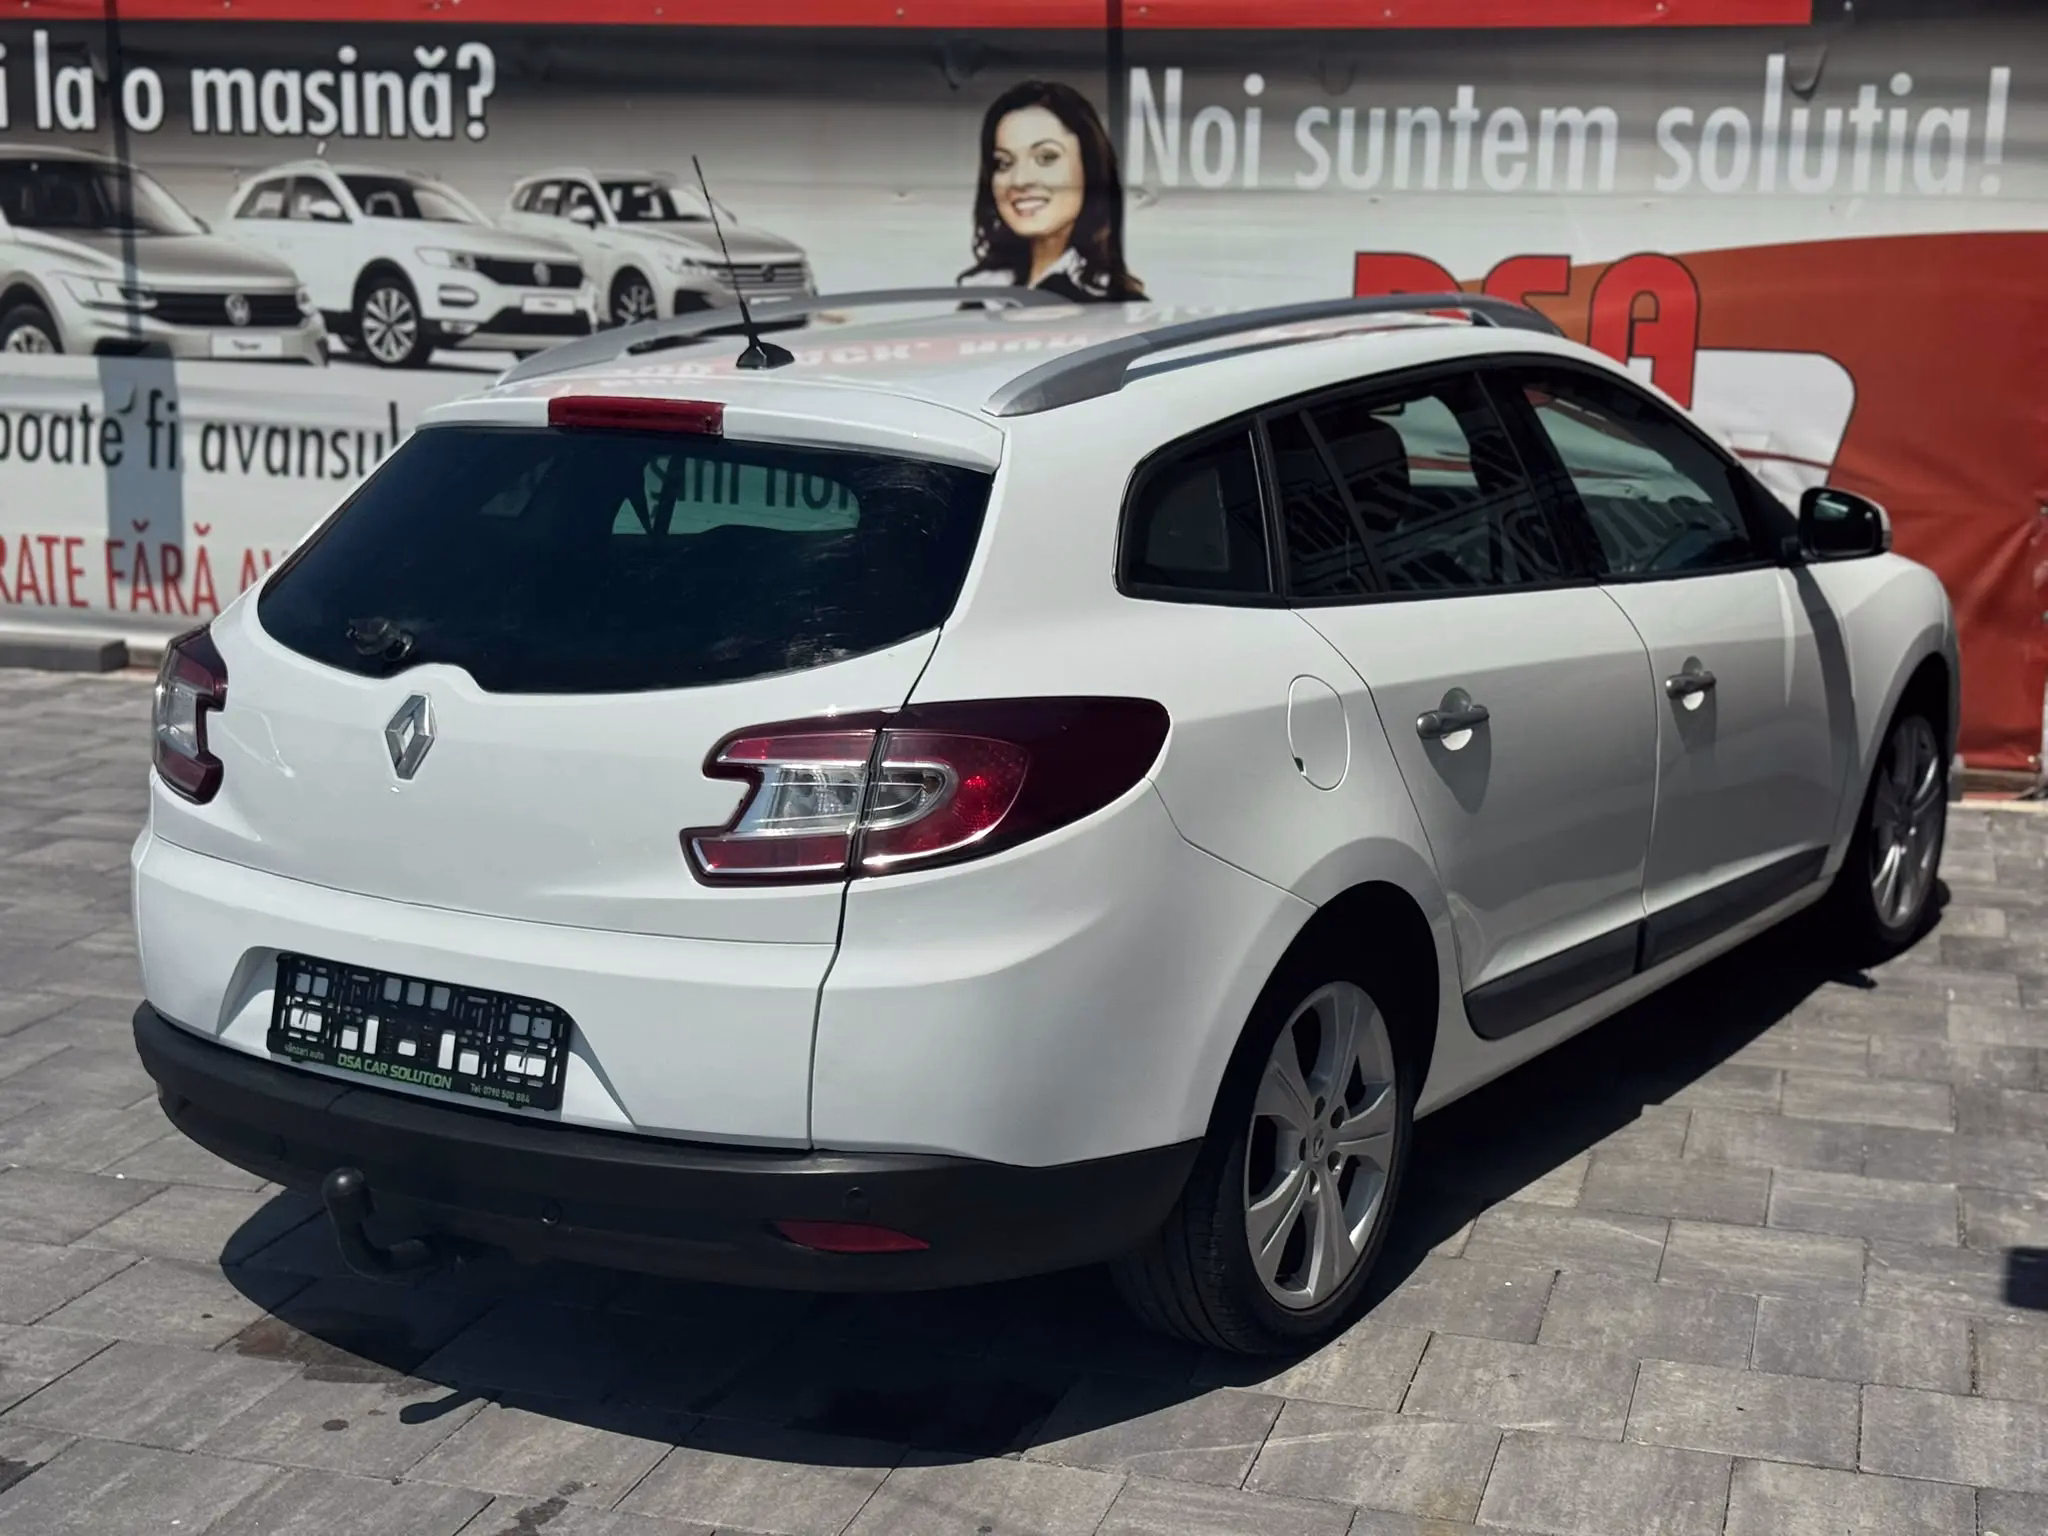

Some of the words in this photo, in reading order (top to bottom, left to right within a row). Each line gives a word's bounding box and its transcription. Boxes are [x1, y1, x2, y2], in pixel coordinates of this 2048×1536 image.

[34, 29, 95, 130] la
[122, 67, 164, 132] o
[190, 42, 497, 155] mașină?
[1126, 67, 1266, 188] Noi
[1294, 83, 1619, 191] suntem
[144, 389, 180, 471] fi
[103, 519, 221, 617] FĂRĂ
[337, 1052, 362, 1071] DSA
[363, 1058, 390, 1077] CAR
[389, 1064, 453, 1090] SOLUTION
